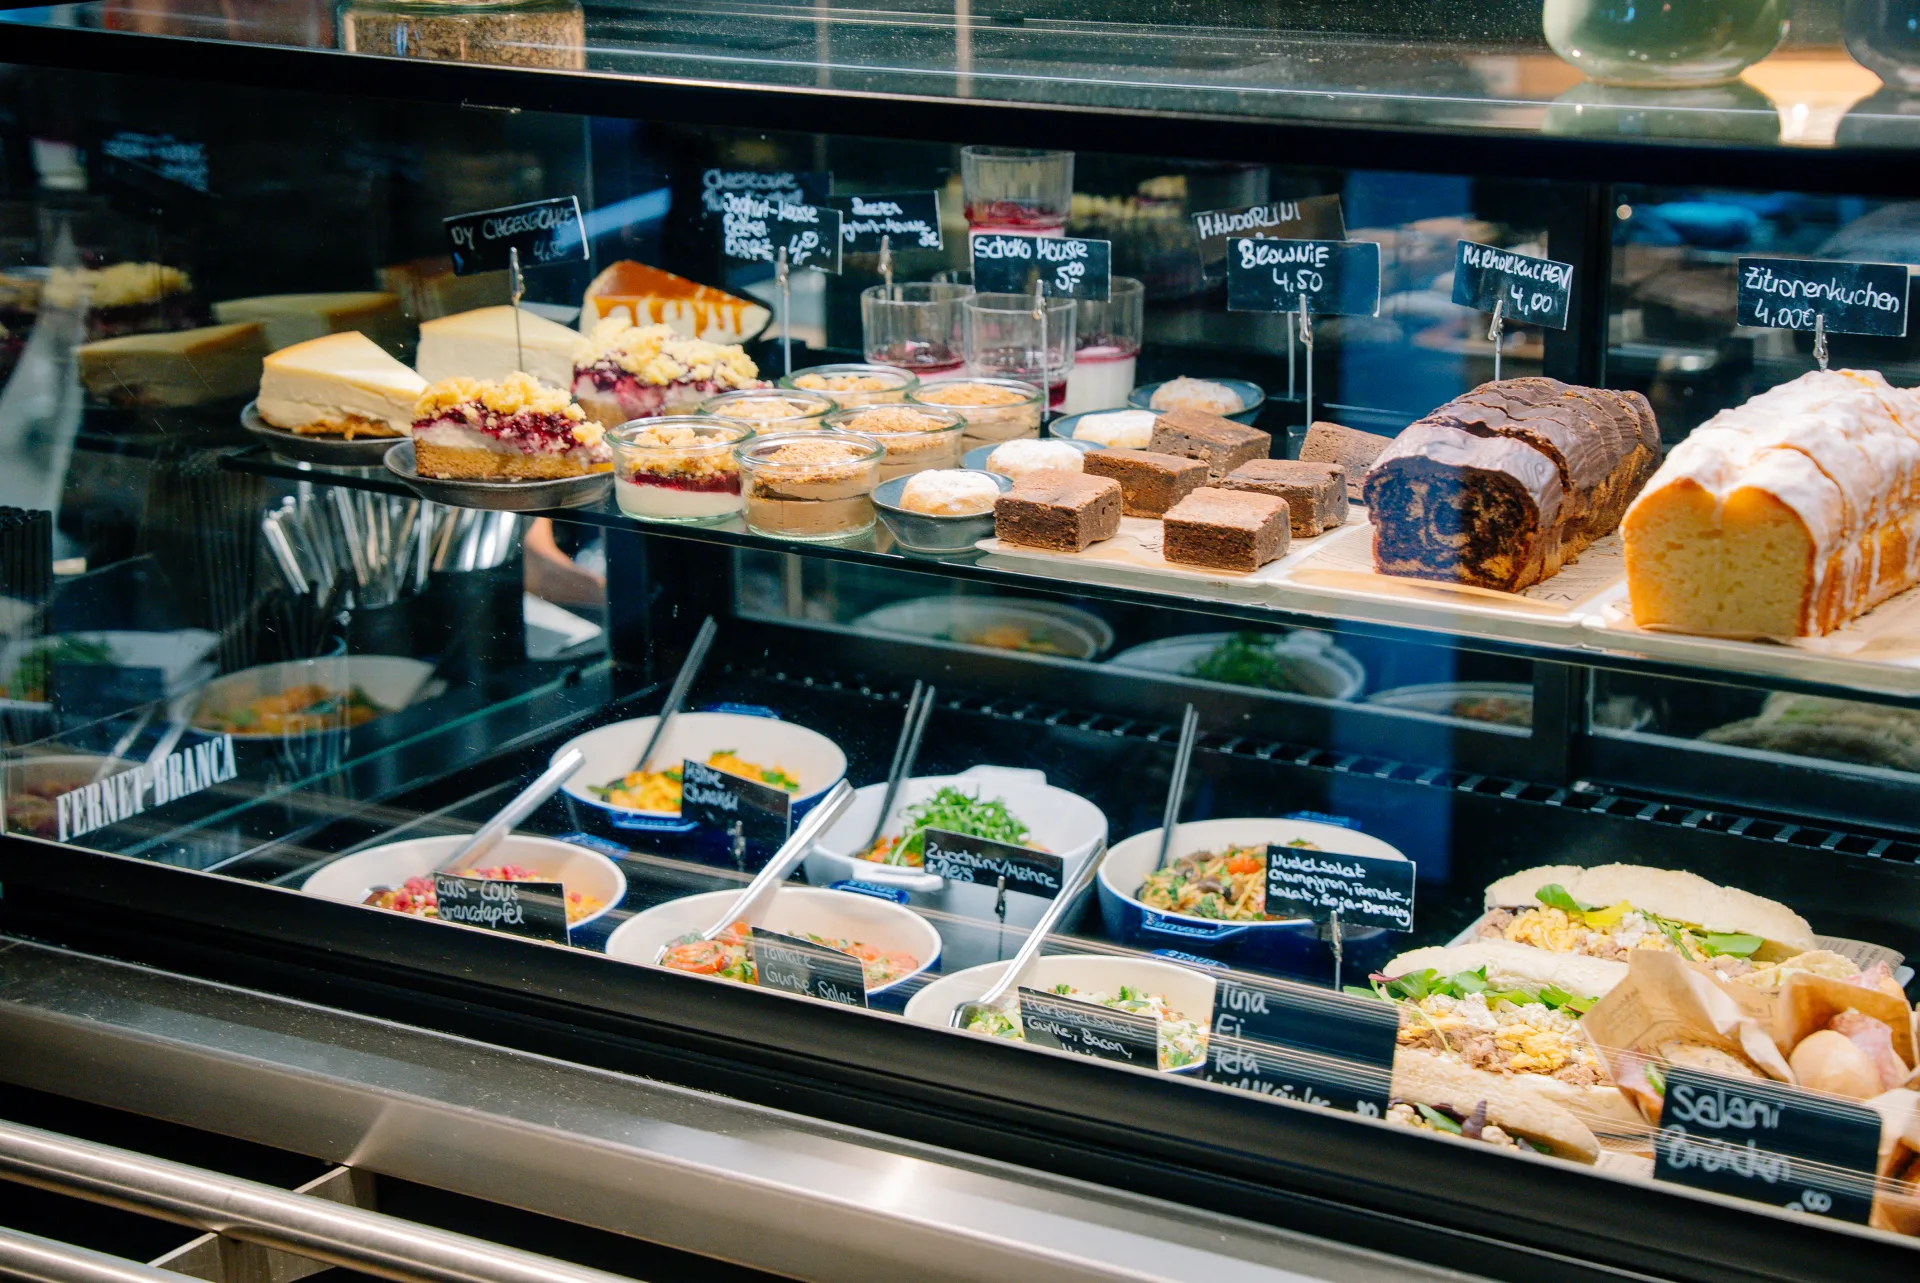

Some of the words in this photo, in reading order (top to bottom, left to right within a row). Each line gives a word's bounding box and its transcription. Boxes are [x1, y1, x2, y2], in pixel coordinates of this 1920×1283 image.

[840, 217, 932, 243] ghurt-Mousse
[1197, 200, 1303, 241] MANDORLINI
[1036, 236, 1089, 262] Mousse
[1272, 267, 1324, 294] 4,50
[1744, 265, 1901, 314] Zitronenkuchen
[1510, 283, 1553, 316] 4,00
[56, 733, 238, 843] FERNET-BRANCA
[1268, 883, 1320, 907] Salat,
[1671, 1084, 1785, 1130] Salami
